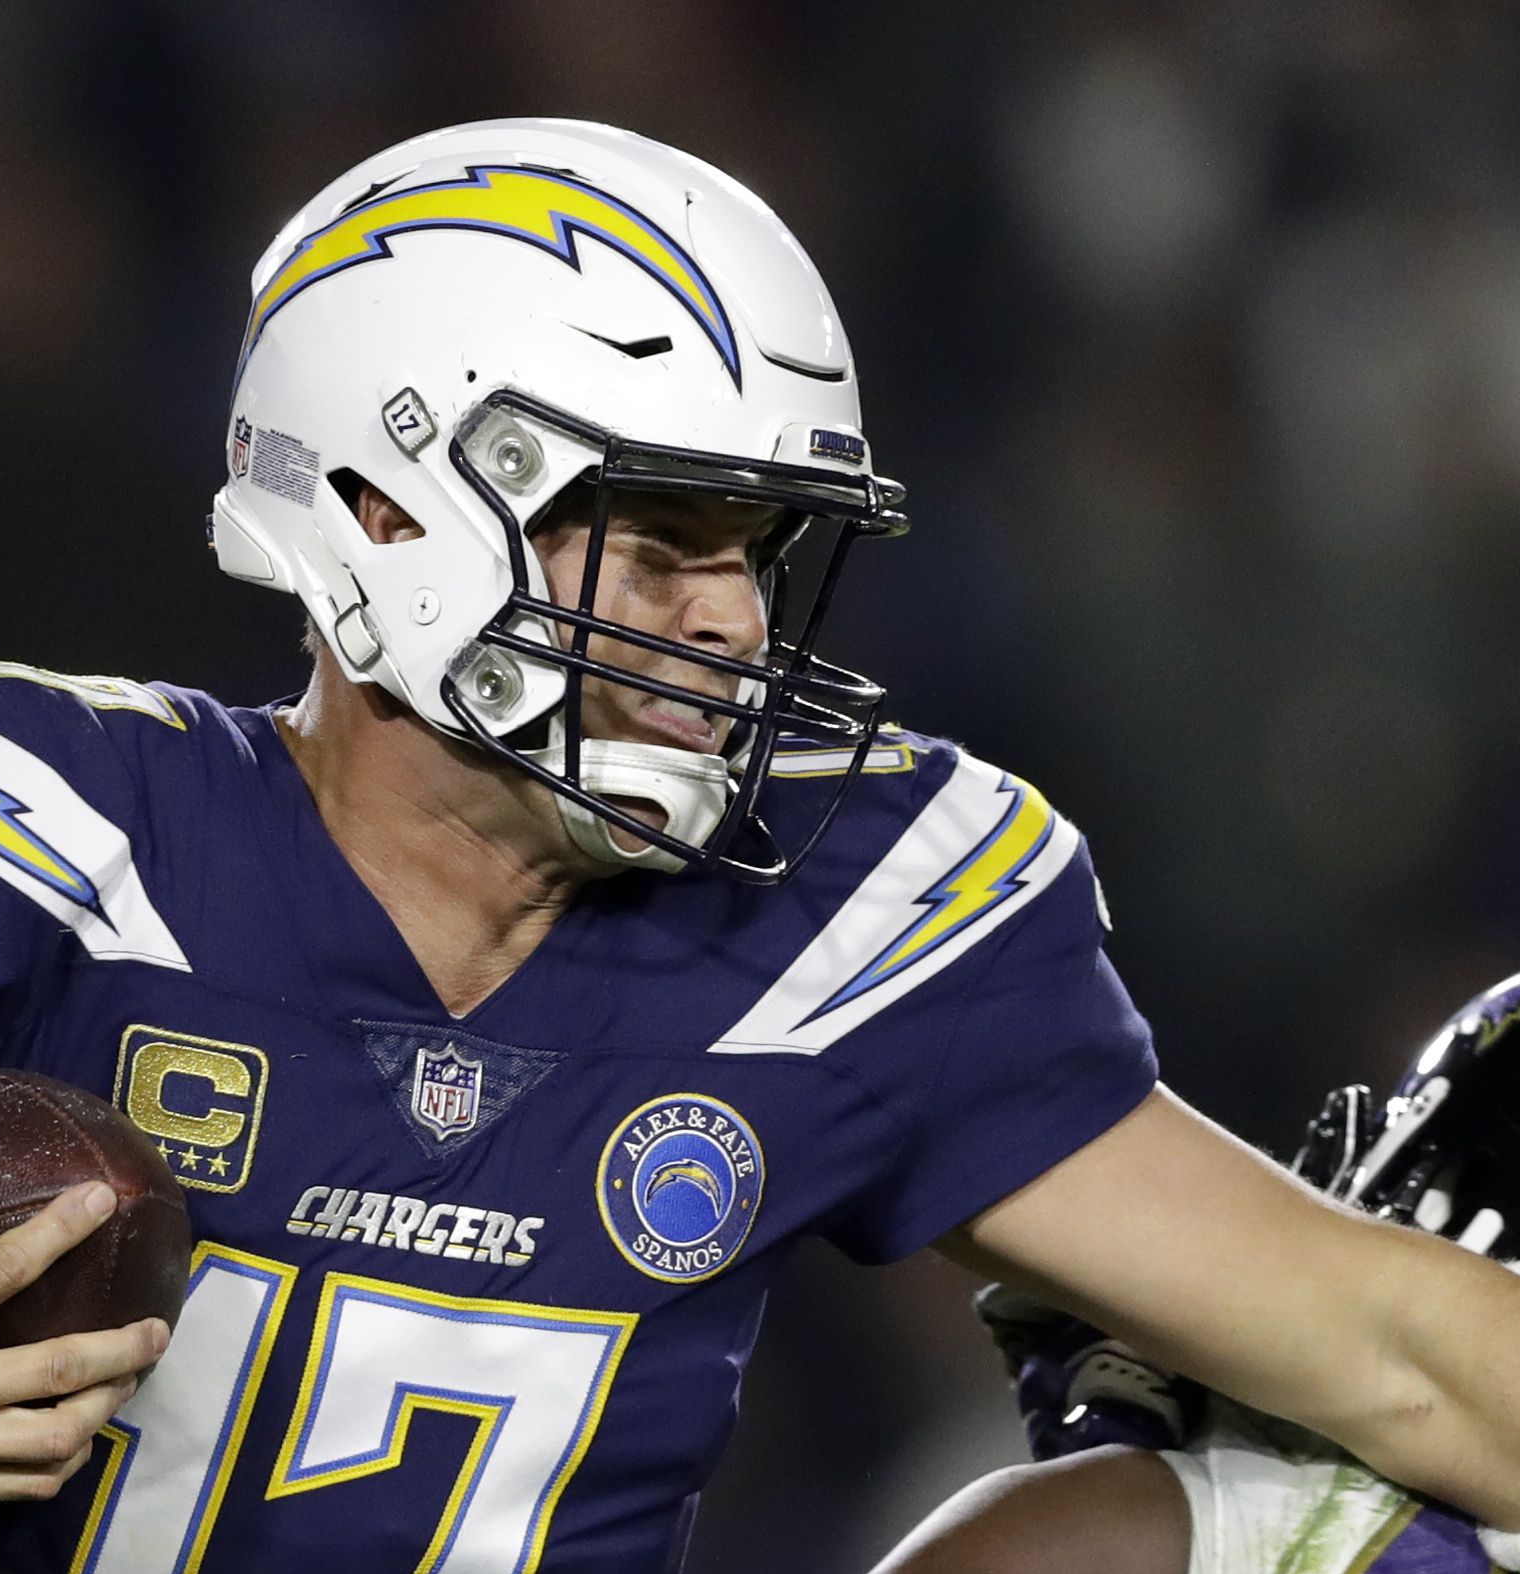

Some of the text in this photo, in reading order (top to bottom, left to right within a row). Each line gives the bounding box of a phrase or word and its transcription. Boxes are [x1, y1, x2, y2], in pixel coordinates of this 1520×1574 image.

[391, 403, 421, 434] 17
[128, 1042, 251, 1147] C
[423, 1083, 468, 1122] NFL
[623, 1107, 754, 1178] ALEX & FAYE
[286, 1185, 544, 1267] CHARGERS
[632, 1233, 723, 1272] SPANOS
